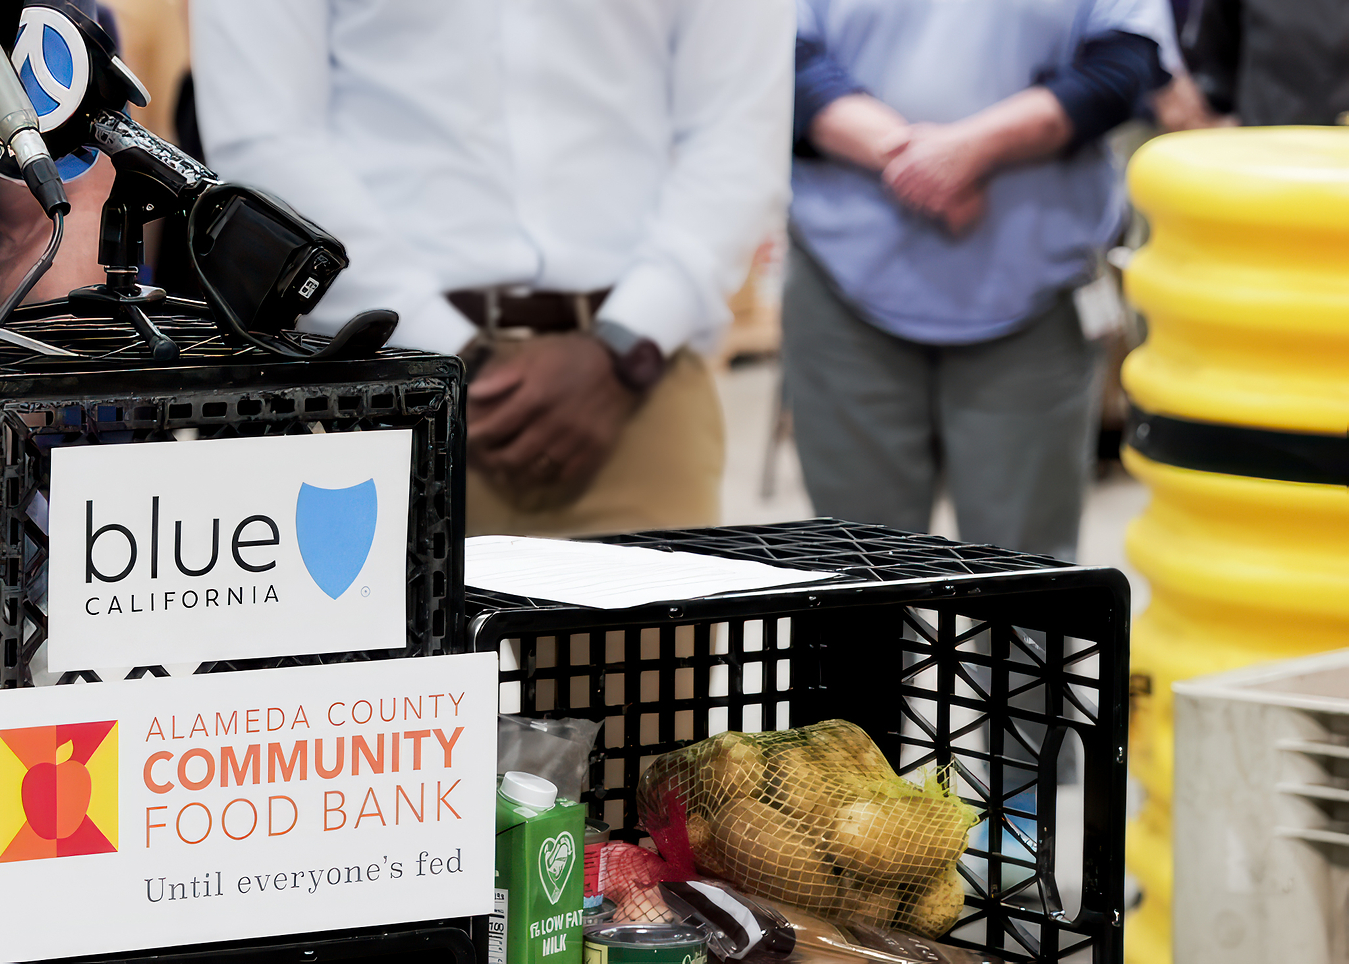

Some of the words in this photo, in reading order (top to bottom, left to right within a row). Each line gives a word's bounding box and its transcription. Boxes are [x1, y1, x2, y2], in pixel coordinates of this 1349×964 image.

[84, 496, 280, 584] blue
[85, 585, 280, 616] CALIFORNIA
[145, 705, 310, 742] ALAMEDA
[327, 691, 466, 728] COUNTY
[143, 727, 466, 794] COMMUNITY
[145, 795, 299, 848] FOOD
[322, 779, 463, 833] BANK
[144, 872, 224, 904] Until
[237, 856, 404, 899] everyone's
[415, 849, 464, 877] fed
[541, 914, 564, 936] LOW
[565, 909, 584, 929] FAT
[542, 933, 567, 957] MILK
